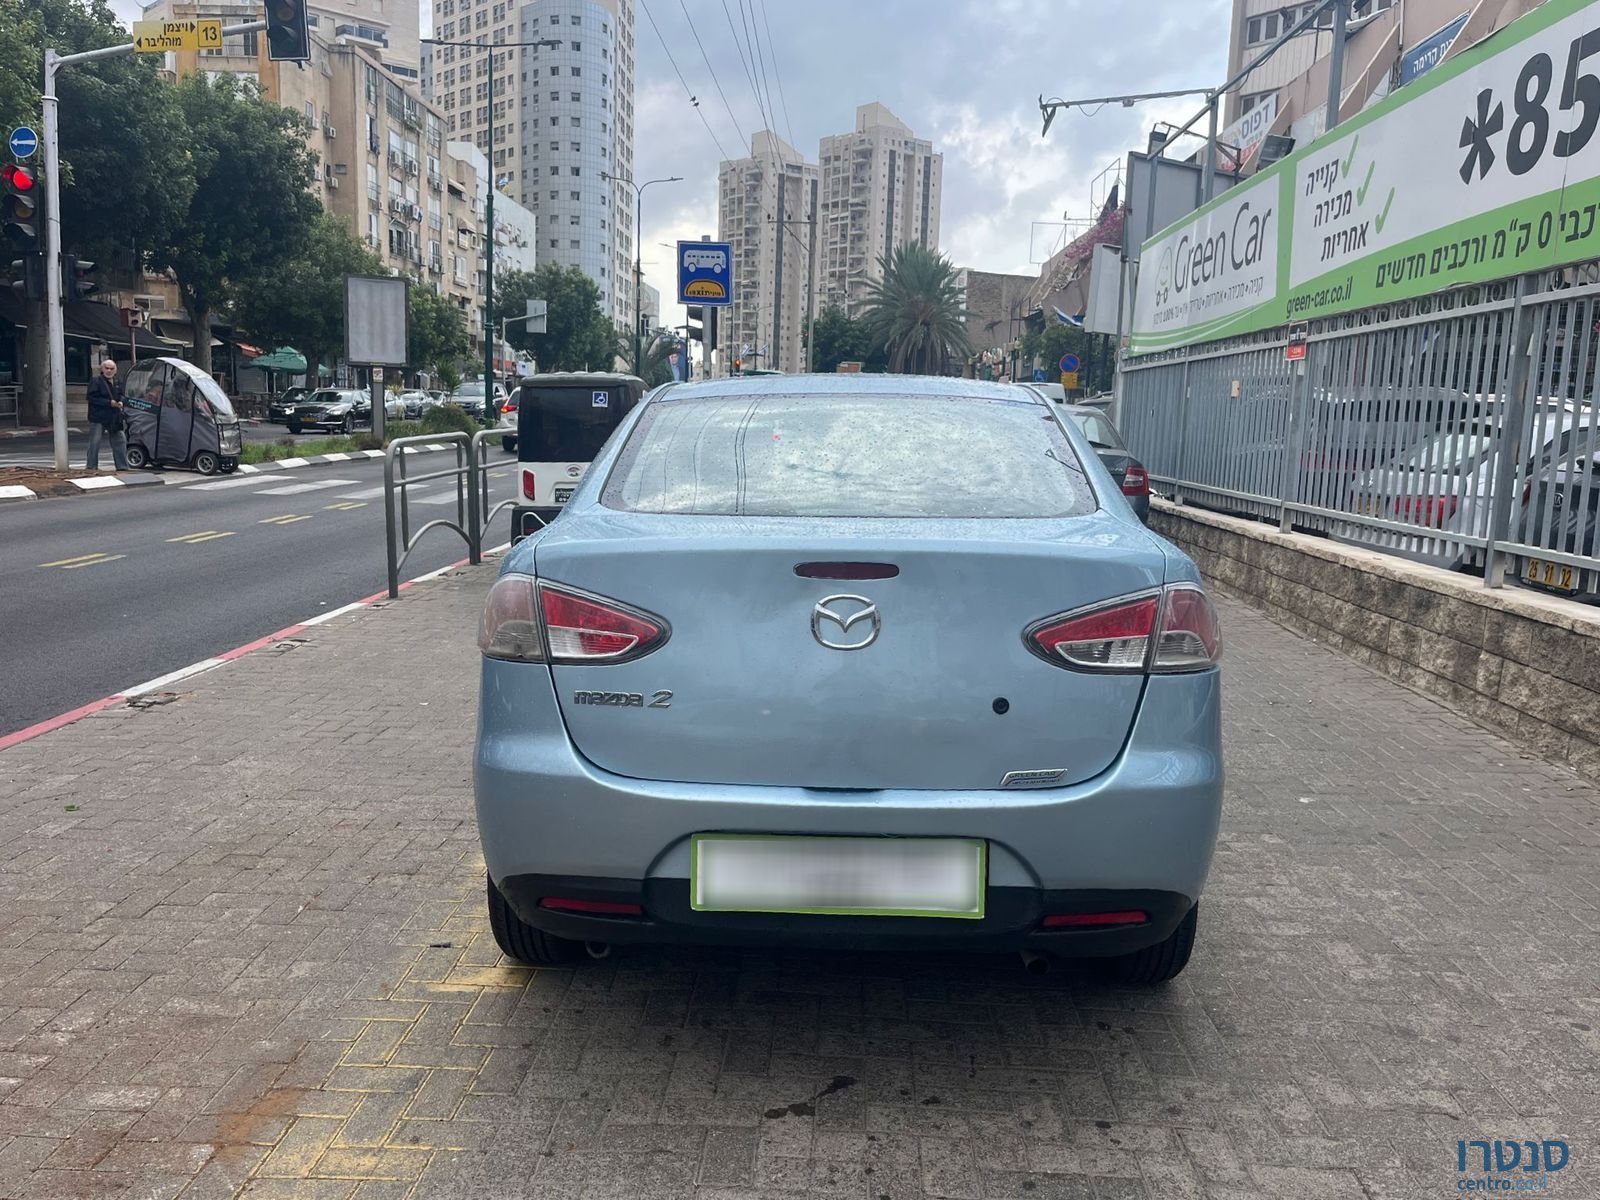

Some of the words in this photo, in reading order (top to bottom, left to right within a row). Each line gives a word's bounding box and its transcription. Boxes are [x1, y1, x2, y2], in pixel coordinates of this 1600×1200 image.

[145, 34, 182, 47] מוהליבר
[164, 22, 188, 35] ויצמן
[202, 26, 218, 41] 13
[1241, 103, 1270, 139] דפוס
[1305, 158, 1339, 197] קנייה
[1313, 189, 1352, 228] מכירה
[1559, 202, 1600, 242] כבי
[1174, 231, 1226, 294] Green
[1231, 202, 1272, 271] Car
[1320, 220, 1369, 262] אחריות
[1537, 210, 1553, 249] 0
[1375, 252, 1426, 289] חדשים
[1429, 233, 1488, 275] ורכבים
[1286, 275, 1354, 319] green-car.co.il
[647, 689, 673, 709] 2
